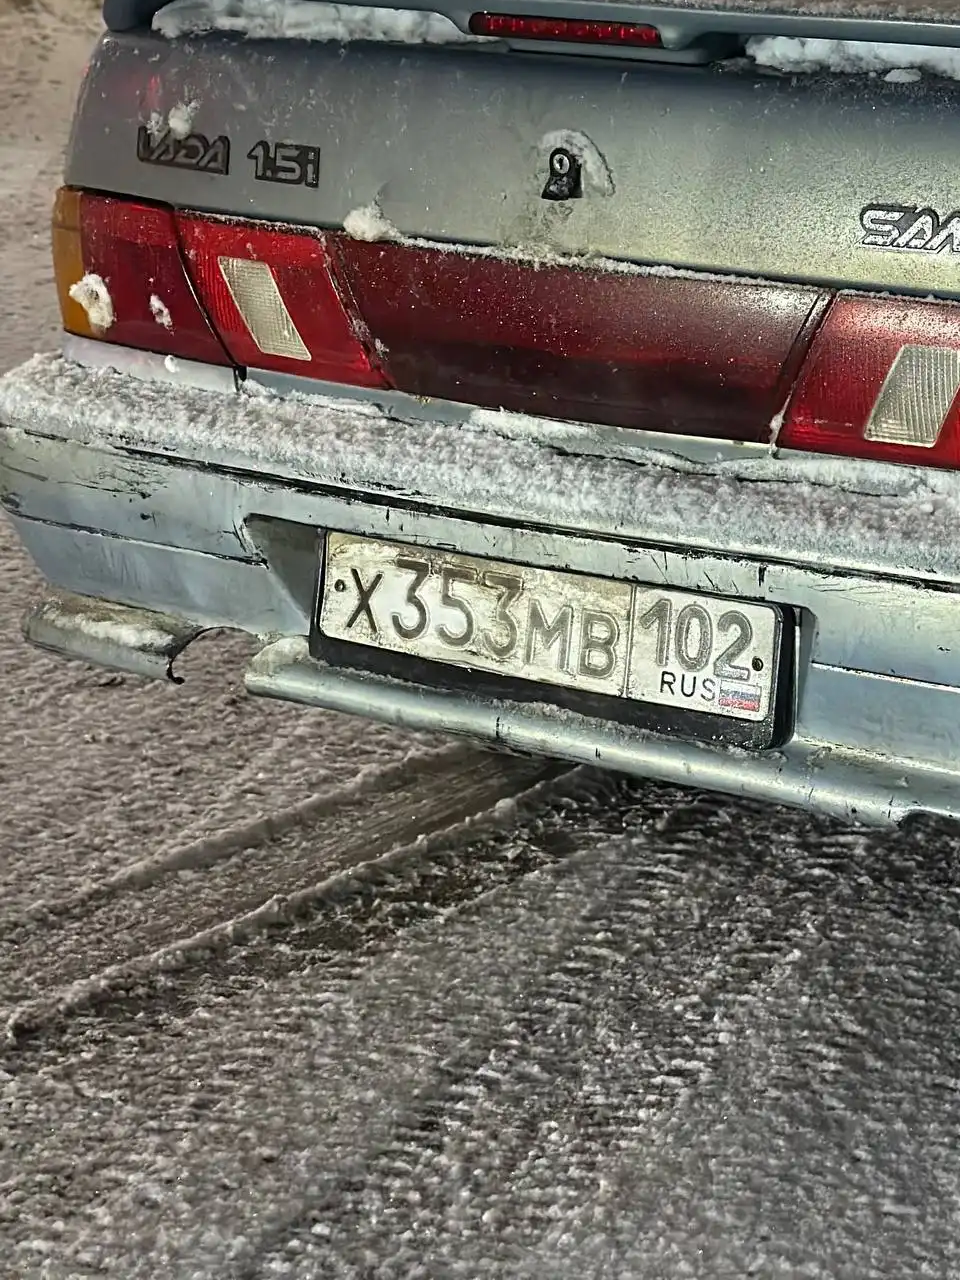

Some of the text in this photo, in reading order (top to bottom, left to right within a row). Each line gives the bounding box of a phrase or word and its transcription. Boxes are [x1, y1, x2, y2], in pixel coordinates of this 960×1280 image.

[246, 139, 321, 188] 1.5i
[639, 597, 755, 682] 102
[659, 671, 716, 701] RUS
